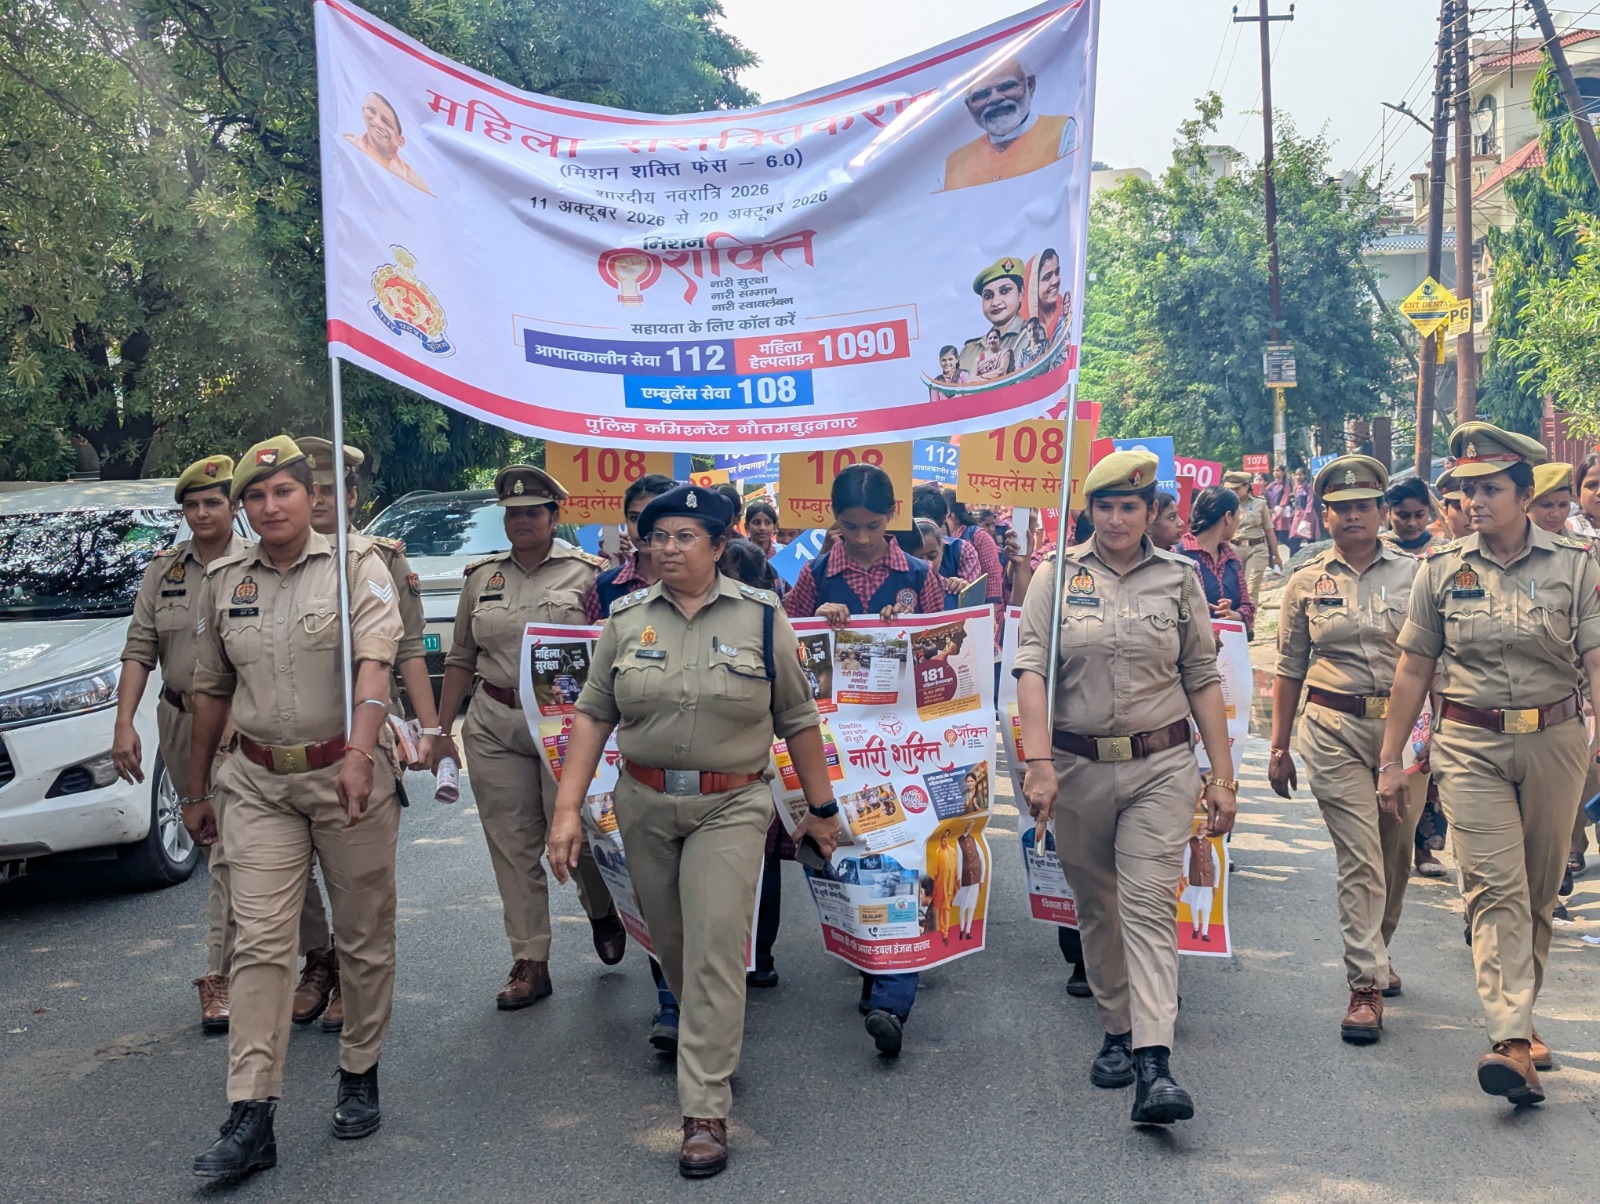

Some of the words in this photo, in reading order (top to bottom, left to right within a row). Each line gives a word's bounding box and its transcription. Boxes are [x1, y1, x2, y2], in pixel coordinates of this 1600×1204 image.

[426, 89, 587, 158] महिला
[560, 164, 619, 180] (मिशन
[630, 160, 681, 178] शक्ति
[691, 157, 728, 174] फेस
[766, 148, 803, 169] 6.0)
[595, 188, 656, 204] शारदीय
[664, 182, 722, 203] नवरात्रि
[731, 183, 769, 199] 2026
[530, 196, 547, 210] 11
[558, 200, 618, 223] अक्टूबर
[627, 210, 665, 227] 2026
[675, 209, 690, 225] से
[700, 211, 718, 223] 20
[728, 202, 785, 222] अक्टूबर
[792, 190, 828, 209] 2026
[642, 236, 705, 251] मिशन
[662, 229, 818, 306] शक्ति
[710, 277, 734, 289] नारी
[737, 275, 769, 290] सुरक्षा
[711, 289, 735, 301] नारी
[738, 287, 778, 299] सम्मान
[1422, 300, 1451, 308] DENTA
[711, 300, 736, 312] नारी
[1450, 306, 1469, 323] PG
[630, 322, 684, 335] सहायता
[687, 319, 703, 334] के
[705, 318, 735, 333] लिए
[738, 314, 770, 331] कॉल
[774, 311, 797, 327] करें
[758, 339, 803, 355] महिला
[818, 327, 896, 362] 1090
[534, 344, 627, 366] आपातकालीन
[630, 352, 661, 367] सेवा
[665, 344, 726, 372] 112
[749, 352, 815, 370] हेल्पलाइन
[640, 384, 697, 404] एम्बुलेंस
[700, 385, 732, 400] सेवा
[737, 375, 797, 404] 108
[585, 417, 639, 434] पुलिस
[644, 420, 730, 436] कमिश्नरेट
[925, 444, 957, 466] 112
[988, 426, 1064, 464] 108
[572, 448, 647, 483] 108
[1247, 456, 1267, 465] 1076
[966, 469, 1037, 499] एम्बुलेंस
[1174, 461, 1213, 488] 90
[788, 497, 832, 523] एम्बु
[423, 638, 437, 648] 11
[534, 647, 560, 660] महिला
[534, 660, 559, 674] सुरक्षा
[921, 666, 944, 683] 181
[957, 723, 988, 746] शक्ति
[847, 734, 891, 777] नारी
[891, 730, 955, 775] शक्ति
[893, 942, 912, 954] इंजन
